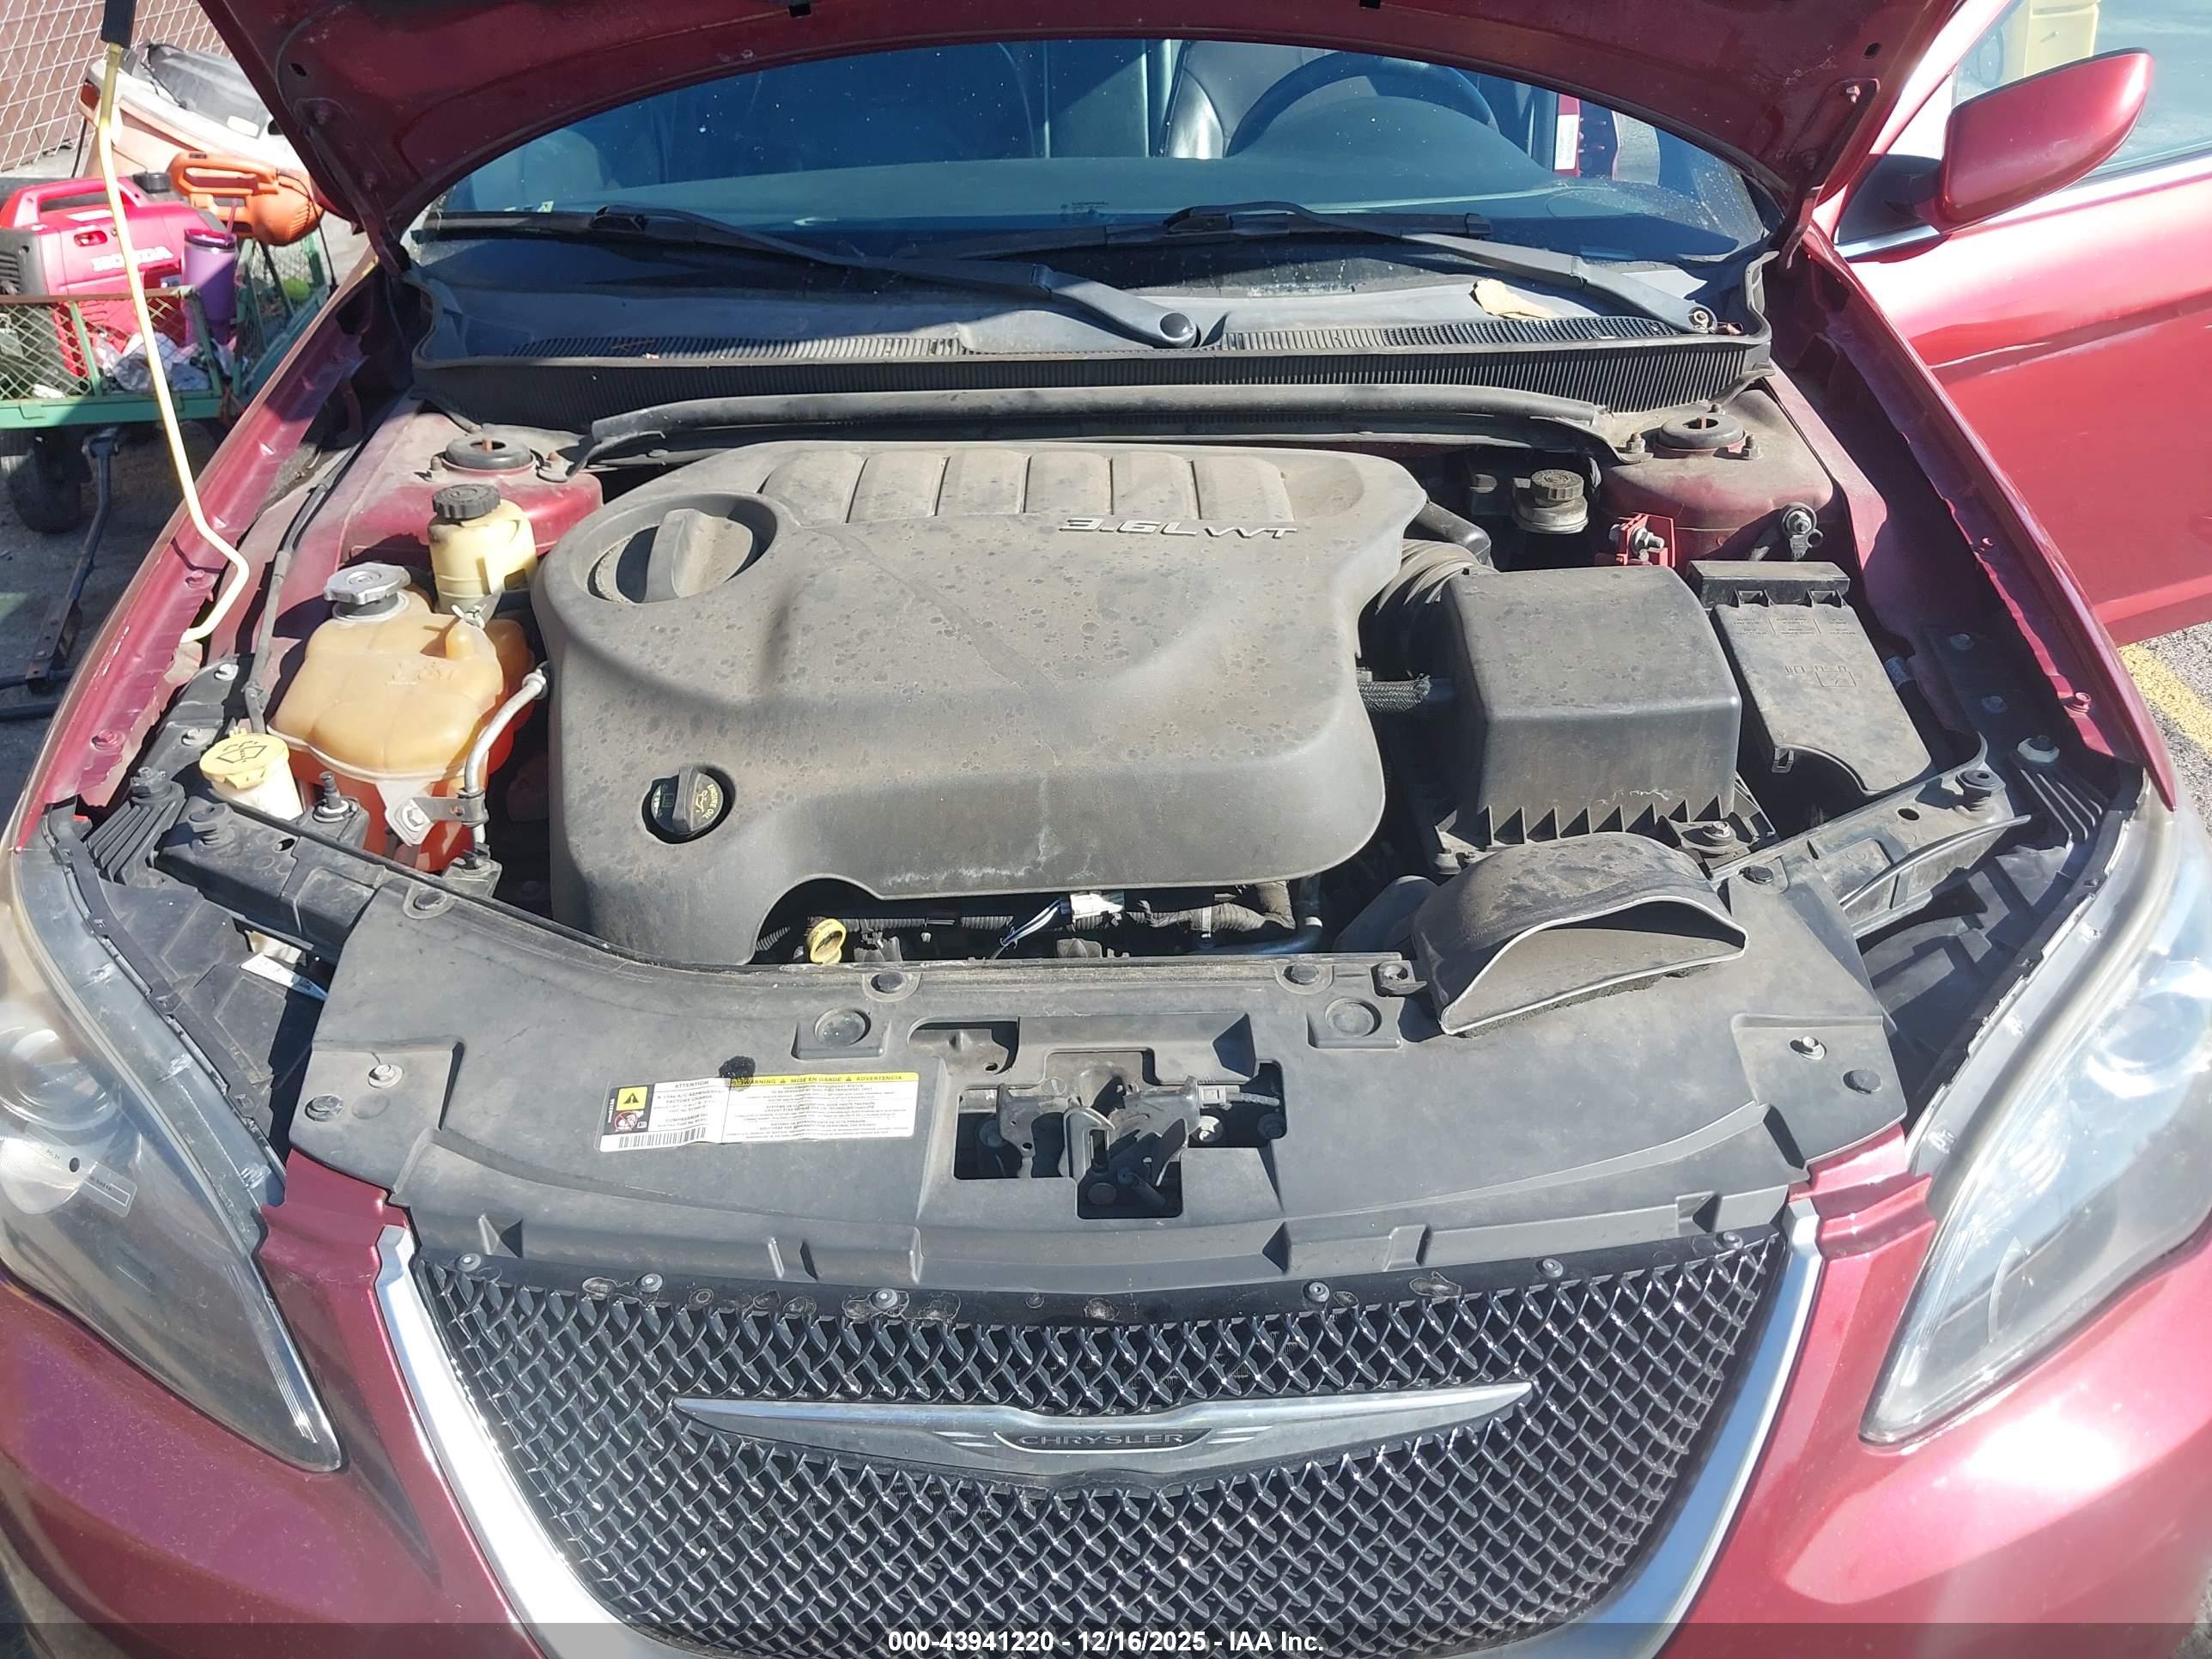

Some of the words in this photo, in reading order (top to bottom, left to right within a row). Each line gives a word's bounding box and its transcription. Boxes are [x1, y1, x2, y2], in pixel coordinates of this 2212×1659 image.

[708, 783, 719, 808] ENGINE
[702, 808, 714, 819] OIL
[674, 1079, 709, 1089] ATTENTION
[1018, 1433, 1183, 1445] CHRYSLER
